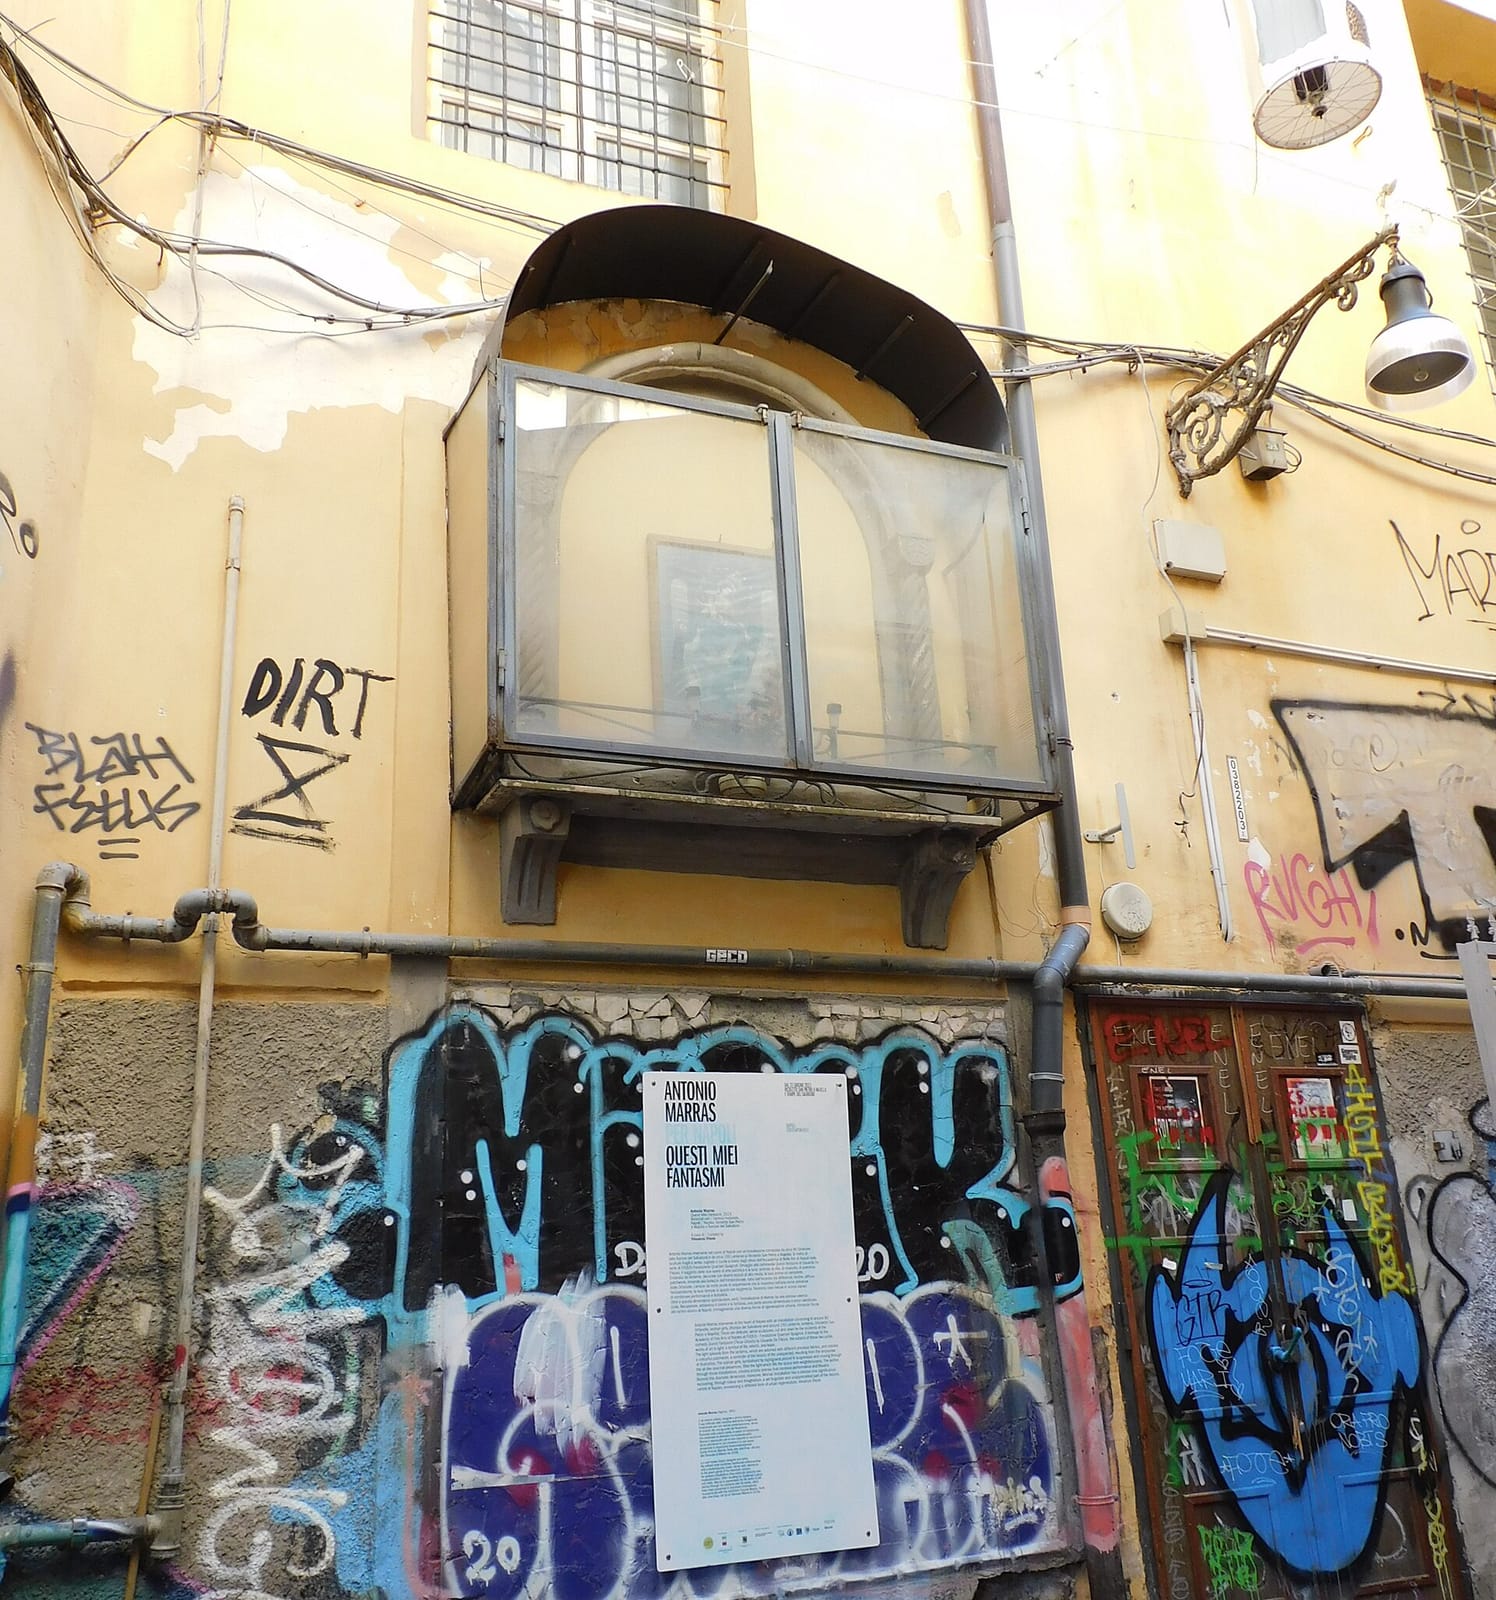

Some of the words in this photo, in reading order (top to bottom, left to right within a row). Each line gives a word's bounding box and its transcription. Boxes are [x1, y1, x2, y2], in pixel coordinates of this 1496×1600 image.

[242, 658, 395, 739] DIRT
[1230, 760, 1246, 831] 0382203
[664, 1080, 717, 1101] ANTONIO
[665, 1102, 717, 1123] MARRAS
[666, 1145, 708, 1167] QUESTI
[713, 1145, 739, 1166] MIEI
[666, 1167, 726, 1189] FANTASMI
[463, 1530, 521, 1587] 20
